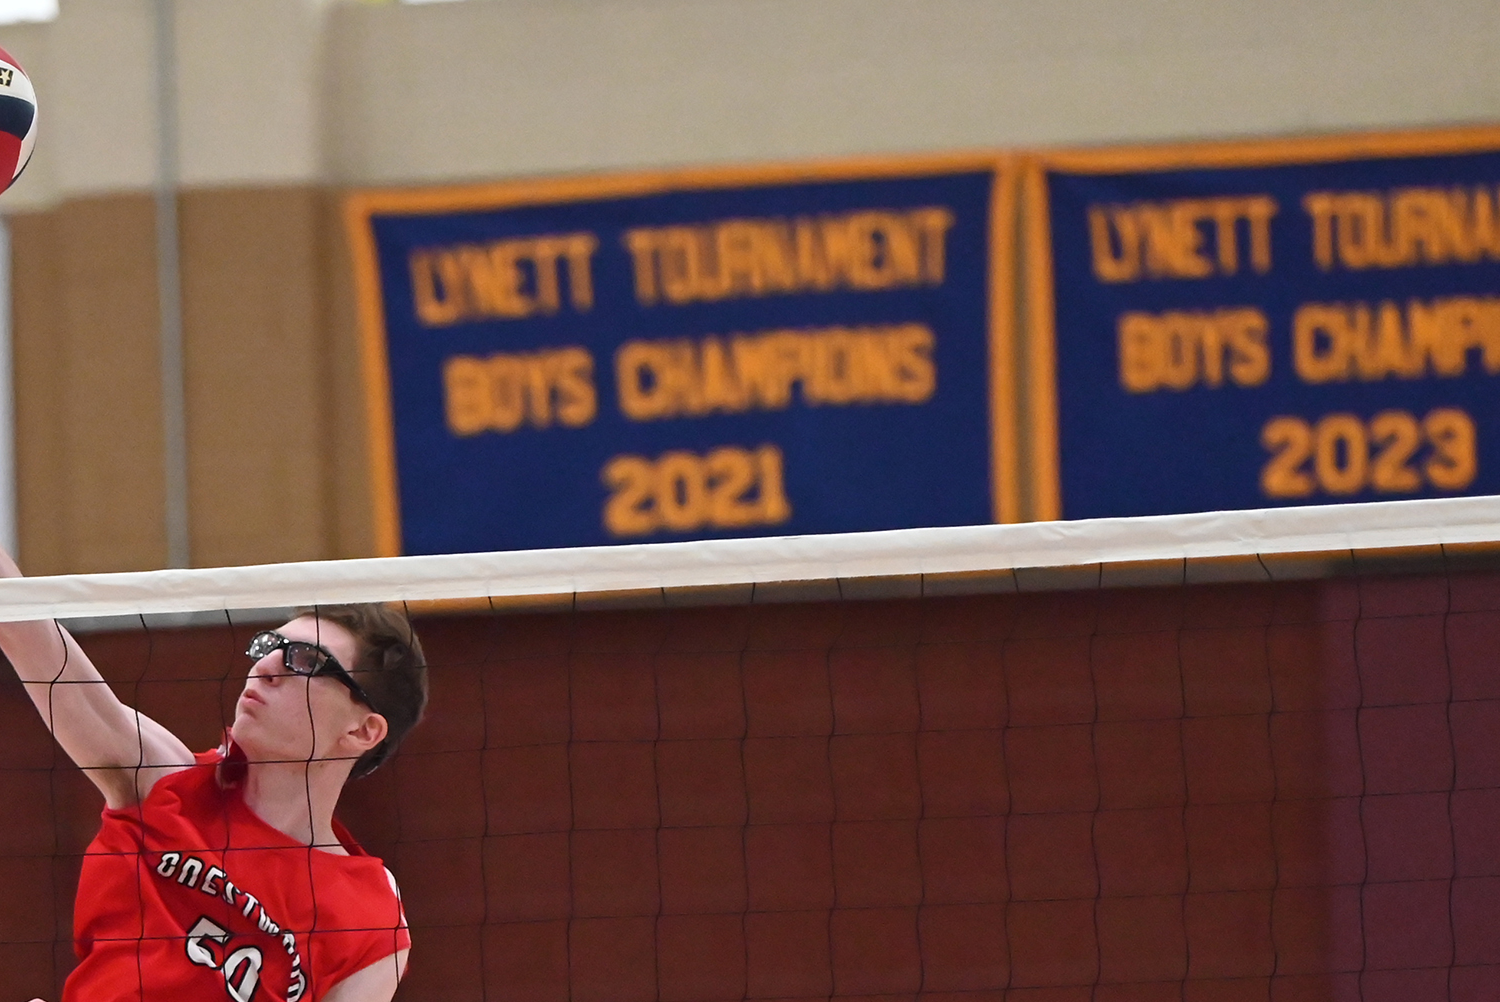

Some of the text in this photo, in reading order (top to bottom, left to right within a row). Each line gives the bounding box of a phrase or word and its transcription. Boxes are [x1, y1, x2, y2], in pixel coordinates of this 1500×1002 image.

[411, 207, 953, 326] LYNETT TOURNAMENT
[1088, 195, 1278, 283] LYNETT
[443, 322, 937, 436] BOYS CHAMPIONS
[1117, 307, 1271, 394] BOYS
[604, 446, 791, 536] 2021
[1261, 407, 1478, 498] 2023
